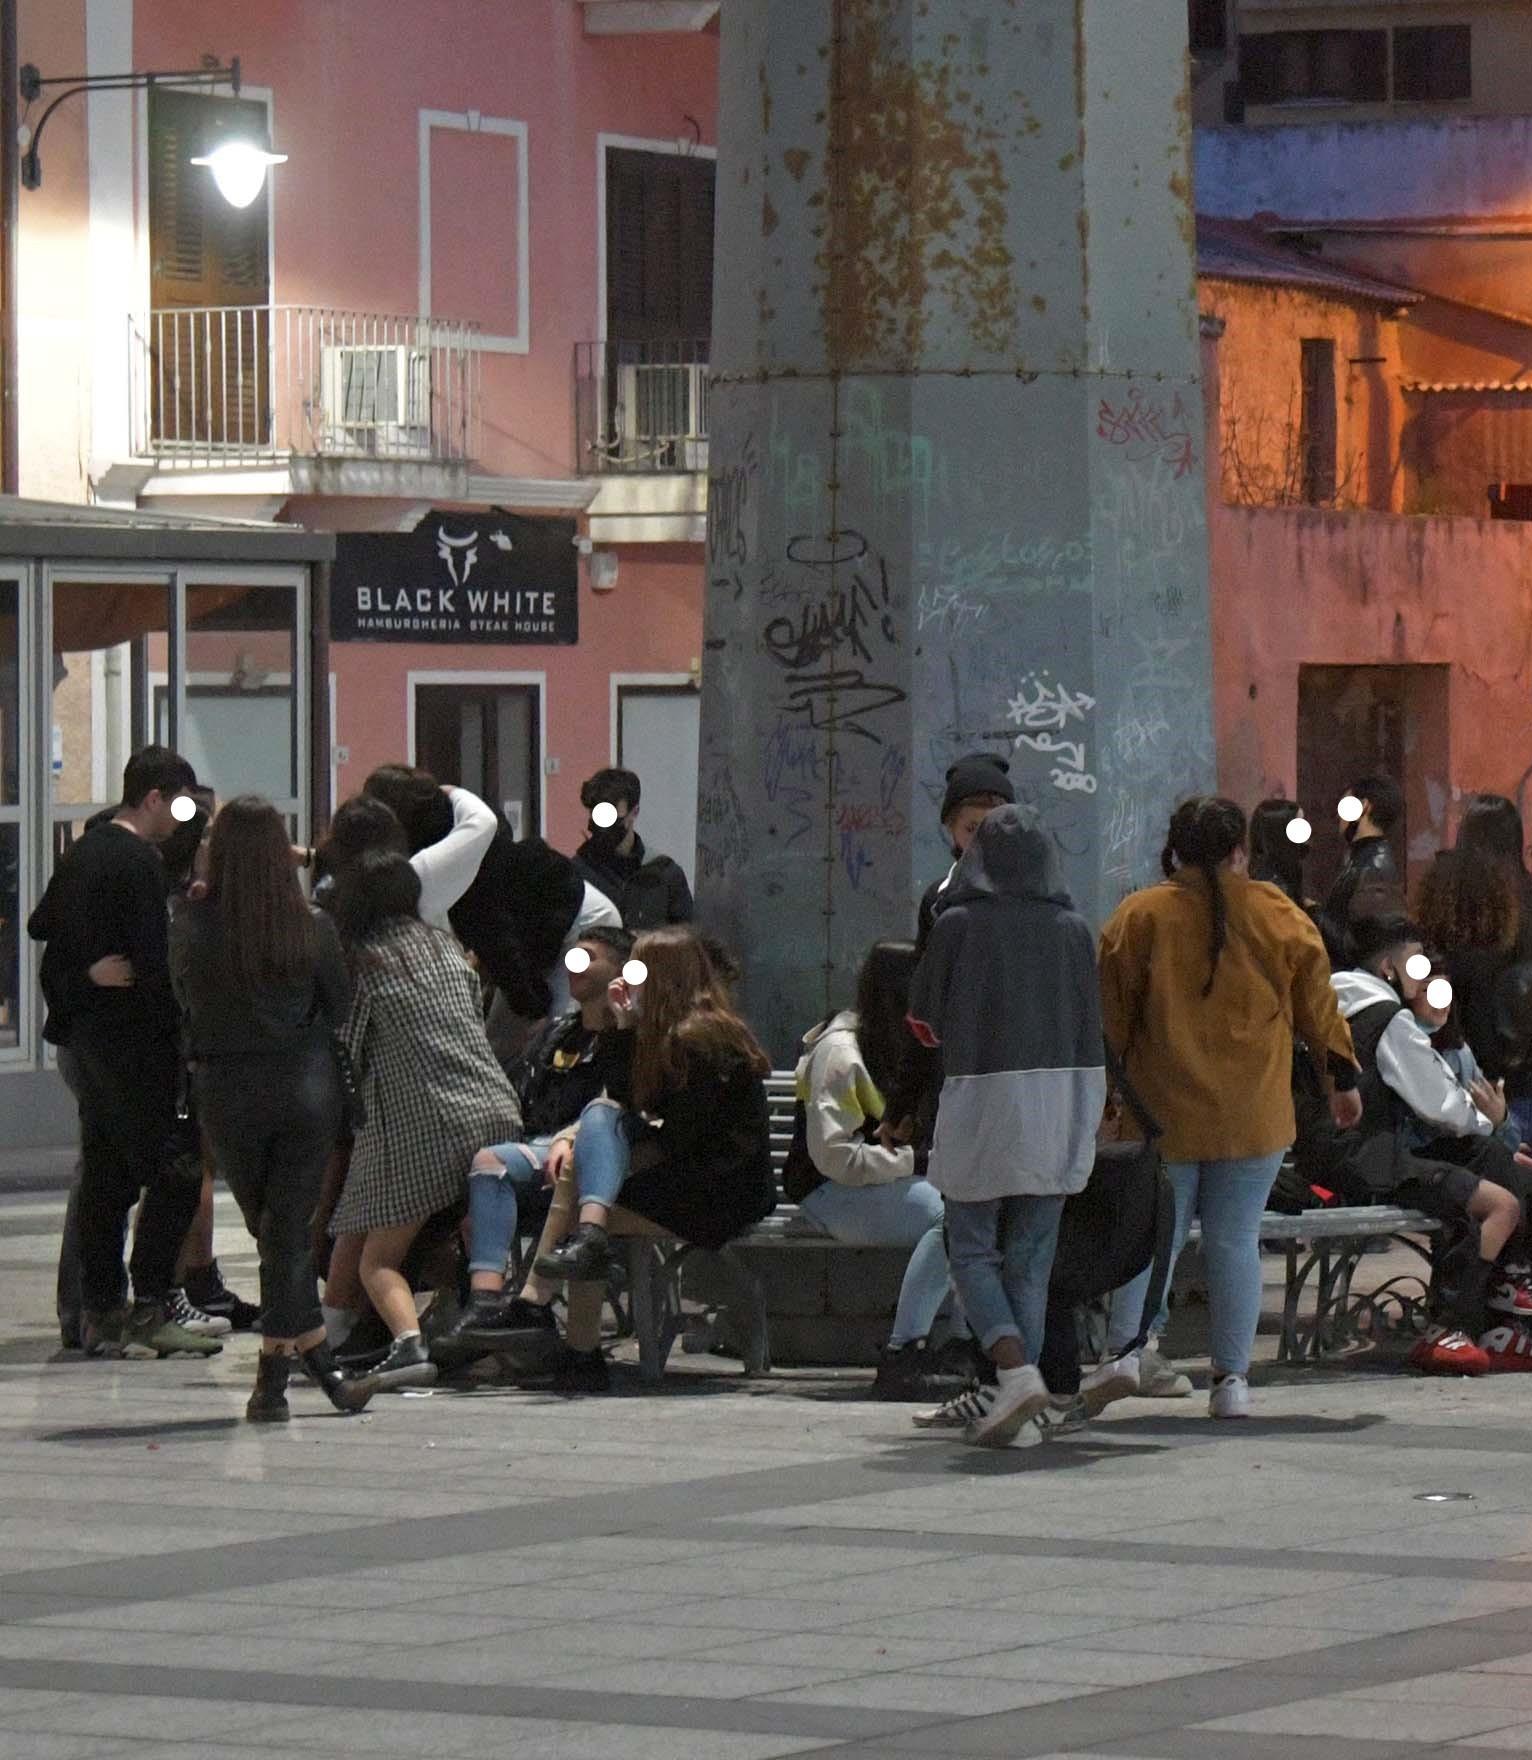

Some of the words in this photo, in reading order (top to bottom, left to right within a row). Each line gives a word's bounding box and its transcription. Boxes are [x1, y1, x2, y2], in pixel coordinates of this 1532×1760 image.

[357, 586, 455, 613] BLACK
[467, 590, 556, 615] WHITE
[357, 617, 461, 631] HAMBURGHERIA
[469, 619, 509, 632] STEAK
[514, 621, 556, 633] HOUSE
